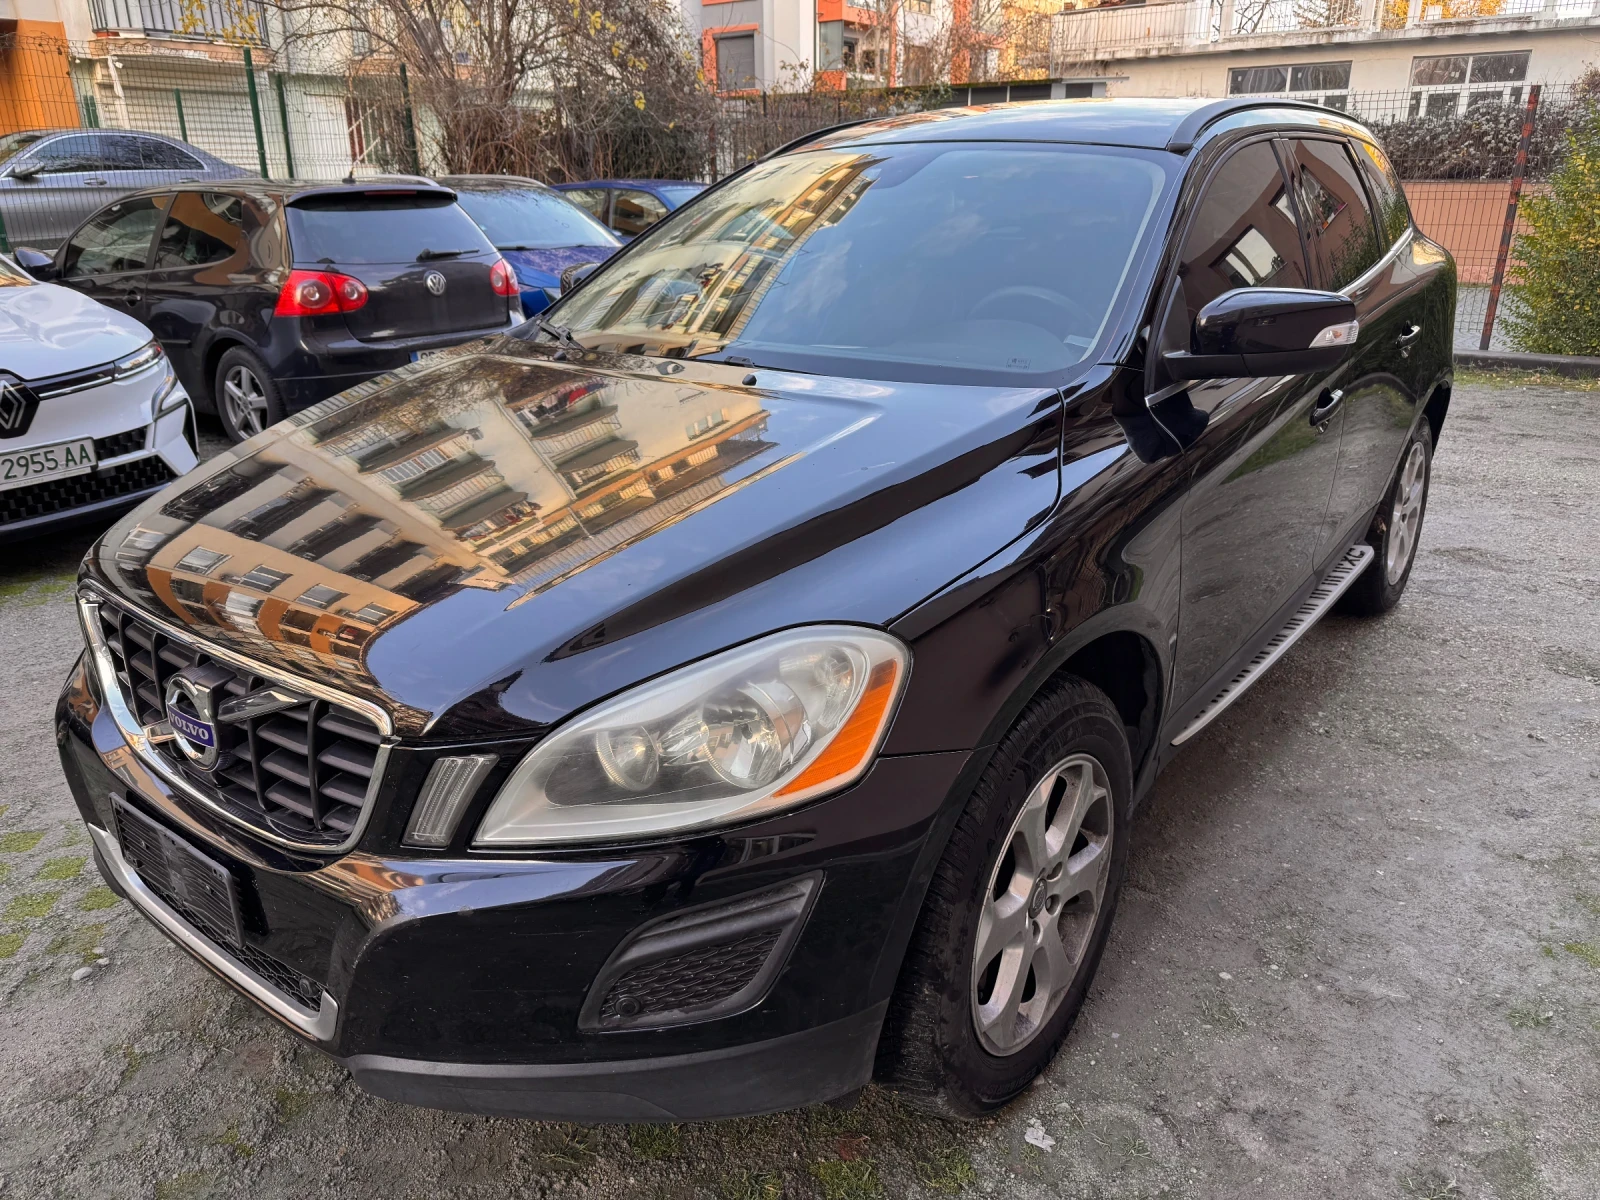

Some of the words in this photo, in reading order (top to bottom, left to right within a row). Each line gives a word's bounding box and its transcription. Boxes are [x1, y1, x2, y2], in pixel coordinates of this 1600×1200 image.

[1, 449, 59, 480] 2955
[65, 443, 92, 468] AA
[1340, 547, 1366, 567] XC
[168, 710, 209, 740] VOLVO
